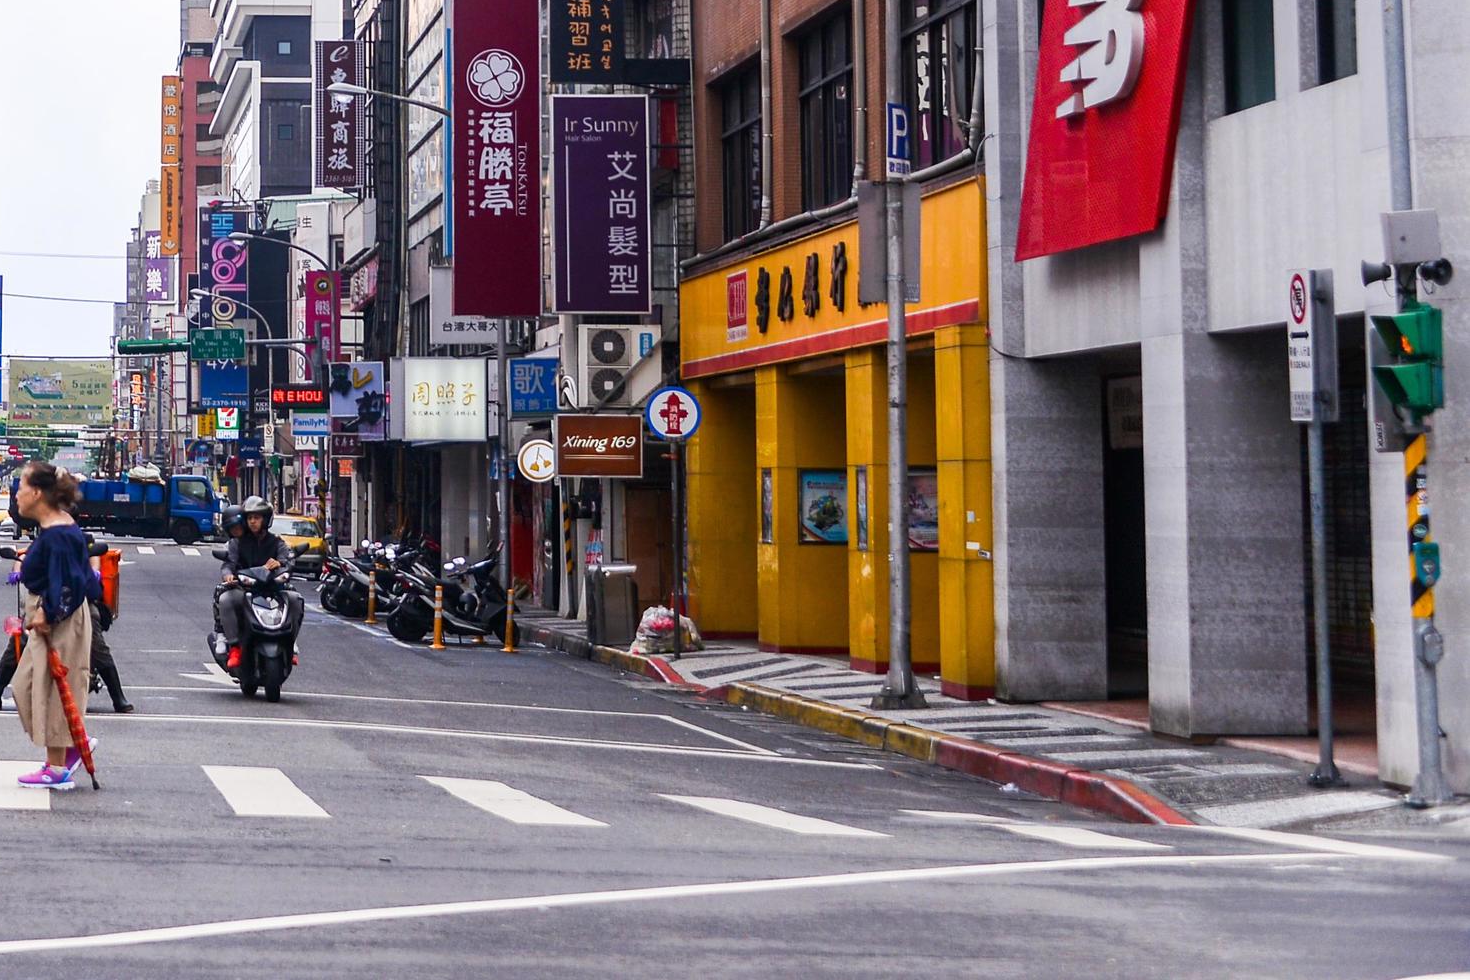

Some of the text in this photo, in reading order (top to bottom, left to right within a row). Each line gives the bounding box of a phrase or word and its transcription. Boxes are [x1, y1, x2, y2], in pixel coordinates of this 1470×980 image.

[564, 117, 640, 137] Ir Sunny
[564, 134, 602, 142] Hair Salon
[891, 107, 909, 159] P
[478, 111, 514, 216] 福勝亭
[517, 141, 528, 216] TONKATSU
[607, 151, 640, 294] 艾尚髮型
[727, 277, 747, 322] CHB
[442, 321, 499, 332] 台灣大哥大
[668, 404, 678, 431] 消防栓
[563, 435, 636, 452] Xining 169
